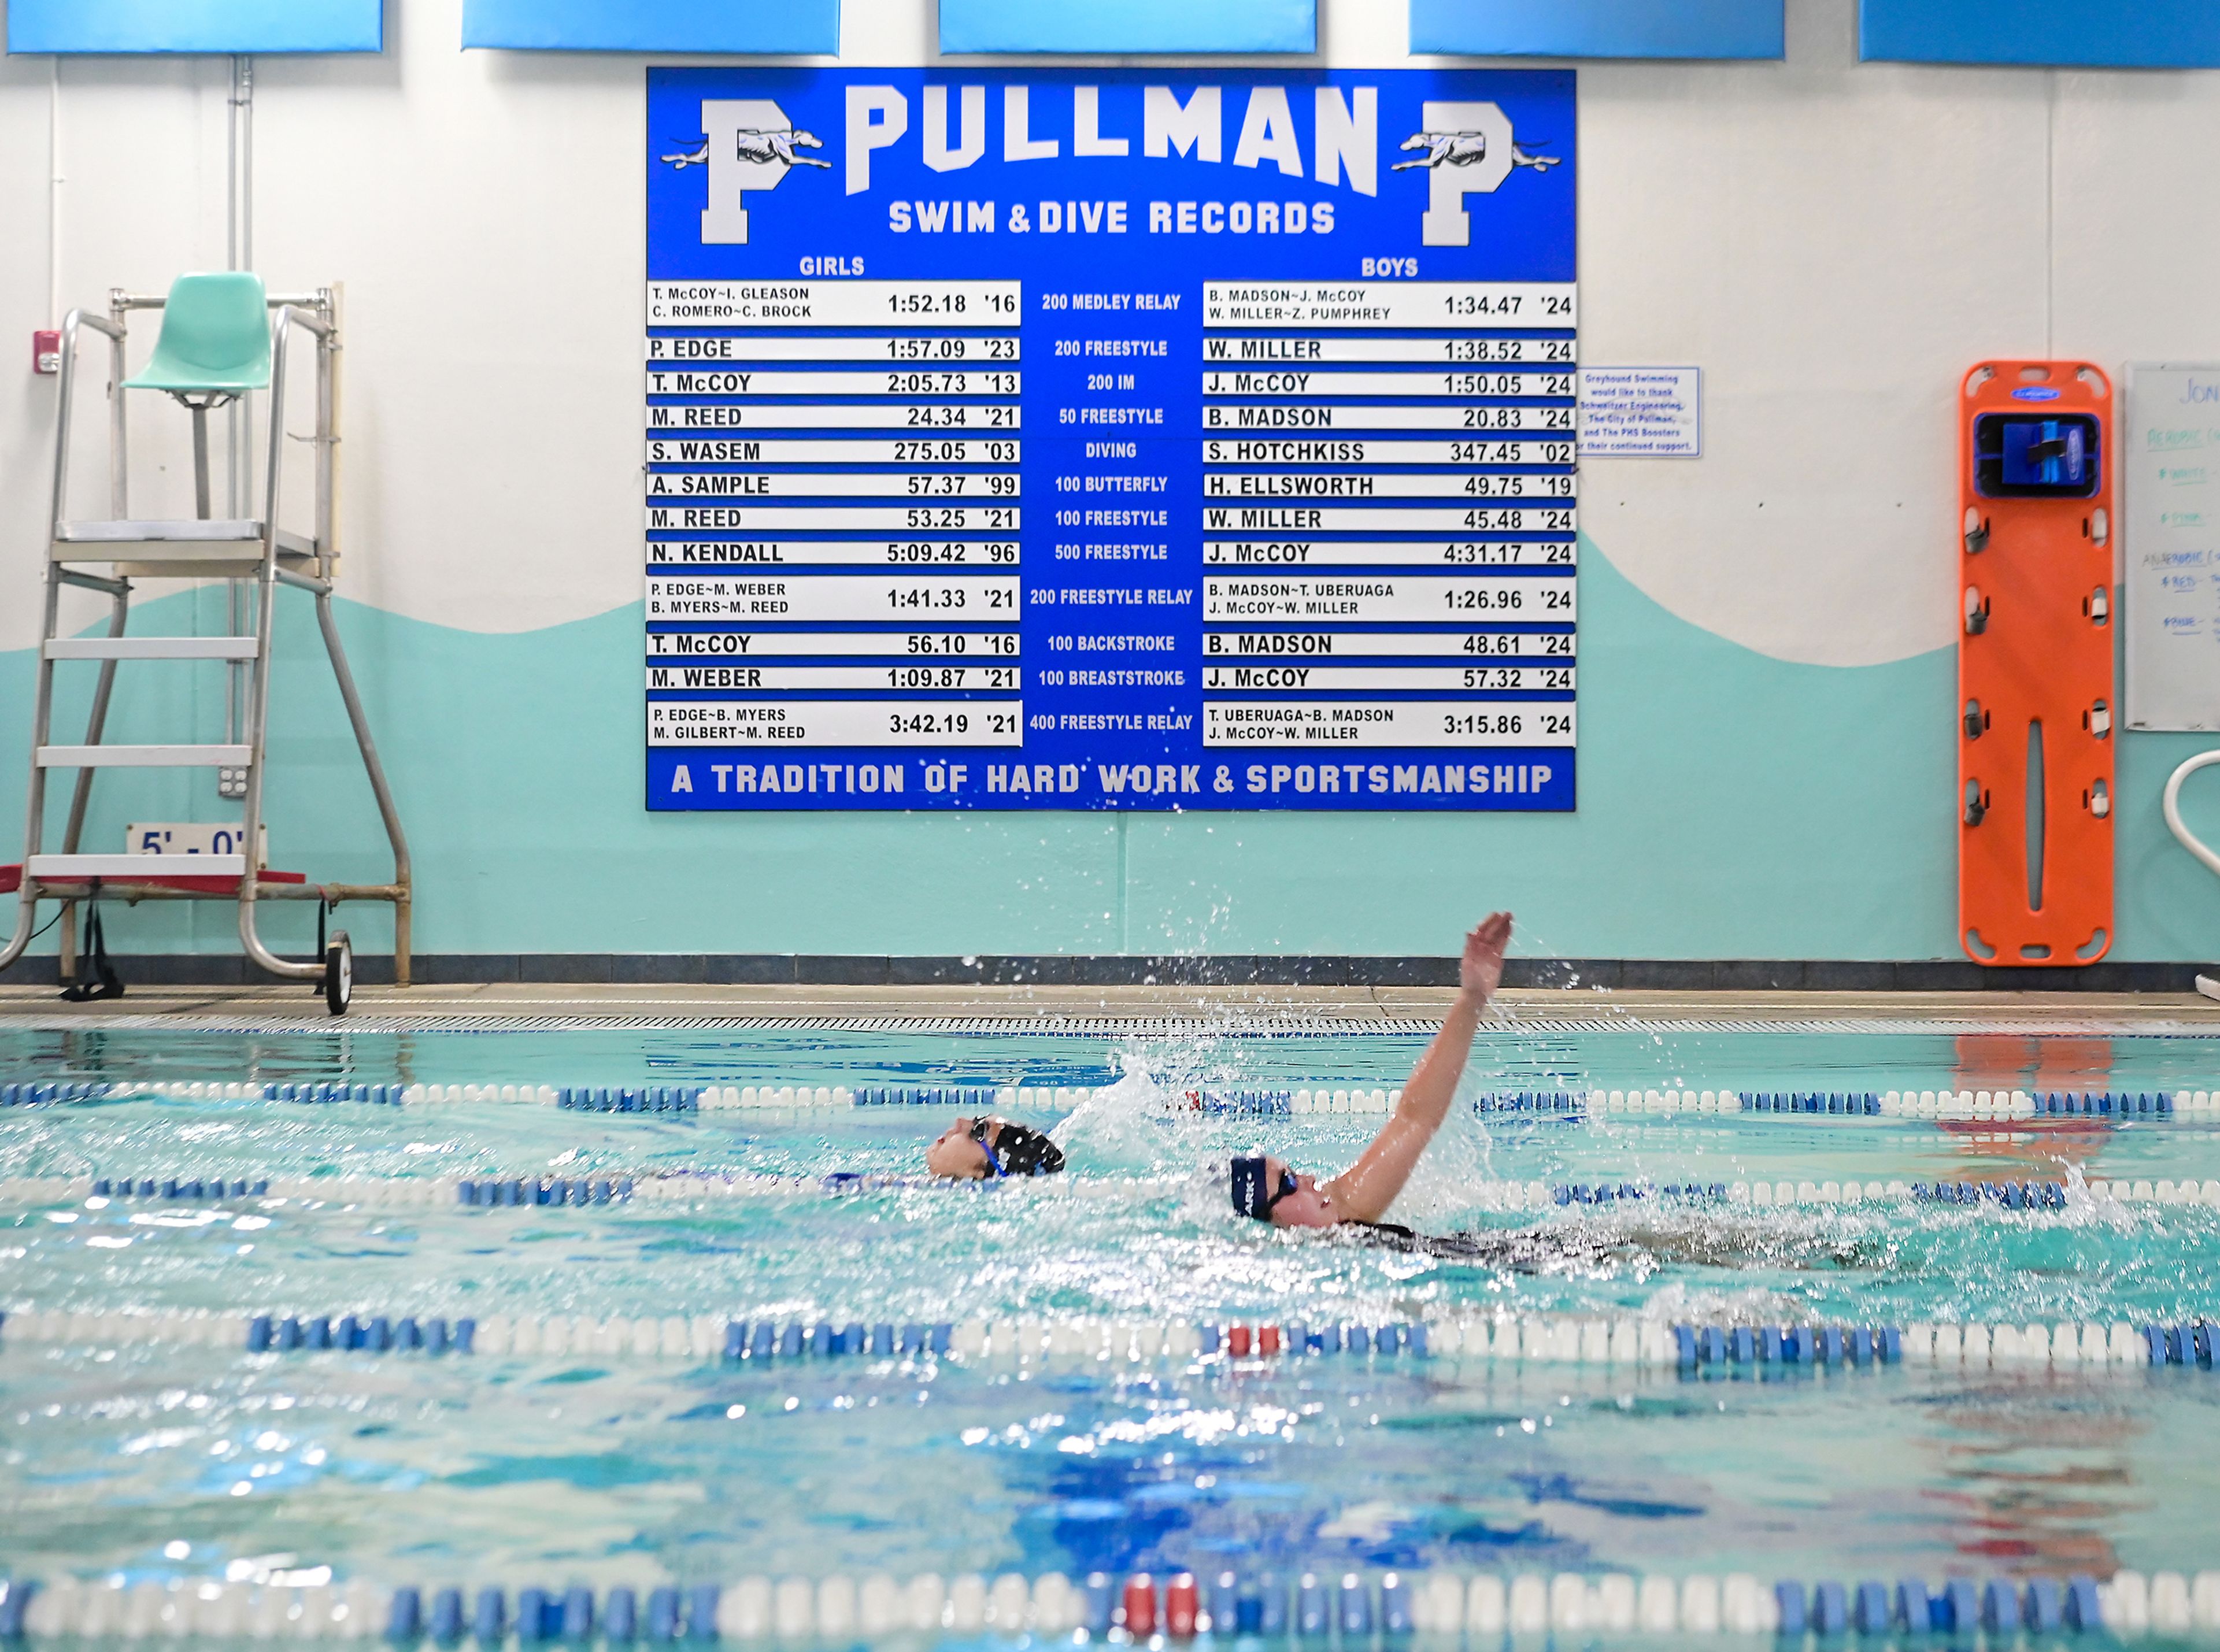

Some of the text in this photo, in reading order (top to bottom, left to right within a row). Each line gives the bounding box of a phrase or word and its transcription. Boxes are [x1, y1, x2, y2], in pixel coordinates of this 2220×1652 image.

[845, 85, 1378, 198] PULLMAN
[889, 201, 1334, 234] SWIM & DIVE RECORDS
[800, 256, 864, 276] GIRLS
[1361, 257, 1418, 277] BOYS
[653, 288, 663, 299] T.
[741, 288, 809, 299] GLEASON
[1042, 294, 1181, 310] 200 MEDLEY RELAY
[1209, 290, 1223, 302] B.
[1317, 290, 1366, 302] McCOY
[653, 306, 666, 317] C.
[762, 306, 811, 317] BROCK
[889, 295, 1015, 312] 1:52.18 '16
[1445, 296, 1571, 315] 1:34.47 '24
[1209, 308, 1224, 319] W.
[1311, 308, 1390, 320] PUMPHREY
[651, 340, 1015, 358] P. EDGE 1:57.09 '23
[1054, 340, 1168, 356] 200 FREESTYLE
[1209, 340, 1571, 360] W. MILLER 1:38.52 '24
[652, 374, 1015, 392] T. McCOY 2:05.73 '13
[1087, 374, 1134, 390] 200 IM
[1208, 374, 1571, 394] J. McCOY 1:50.05 '24
[653, 408, 1013, 426] M. REED 24.34 '21
[1059, 408, 1163, 424] 50 FREESTYLE
[1209, 408, 1570, 428] B. MADSON 20.83 '24
[652, 442, 1015, 461] S. WASEM 275.05 '03
[1086, 442, 1137, 458] DIVING
[1209, 442, 1570, 462] S. HOTCHKISS 347.45 '02
[652, 476, 1015, 495] A. SAMPLE 57.37 '99
[1055, 476, 1168, 492] 100 BUTTERFLY
[1211, 477, 1571, 496] H. ELLSWORTH 49.75 '19
[653, 543, 1015, 562] N. KENDALL 5:09.42 '96
[1055, 544, 1167, 560] 500 FREESTYLE
[1209, 544, 1571, 563] J. McCOY 4:31.17 '24
[888, 589, 1012, 608] 1:41.33 '21
[1030, 589, 1193, 605] 200 FREESTYLE RELAY
[1445, 590, 1571, 609] 1:26.96 '24
[652, 635, 1015, 654] T. McCOY 56.10 '16
[1048, 635, 1175, 651] 100 BACKSTROKE
[1209, 635, 1571, 654] B. MADSON 48.61 '24
[652, 668, 1013, 687] M. WEBER 1:09.87 '21
[1039, 670, 1185, 686] 100 BREASTSTROKE
[1208, 668, 1571, 688] J. McCOY 57.32 '24
[890, 714, 1015, 733] 3:42.19 '21
[1030, 714, 1193, 730] 400 FREESTYLE RELAY
[1444, 715, 1571, 734] 3:15.86 '24
[671, 764, 1552, 793] A TRADITION OF HARD WORK & SPORTSMANSHIP
